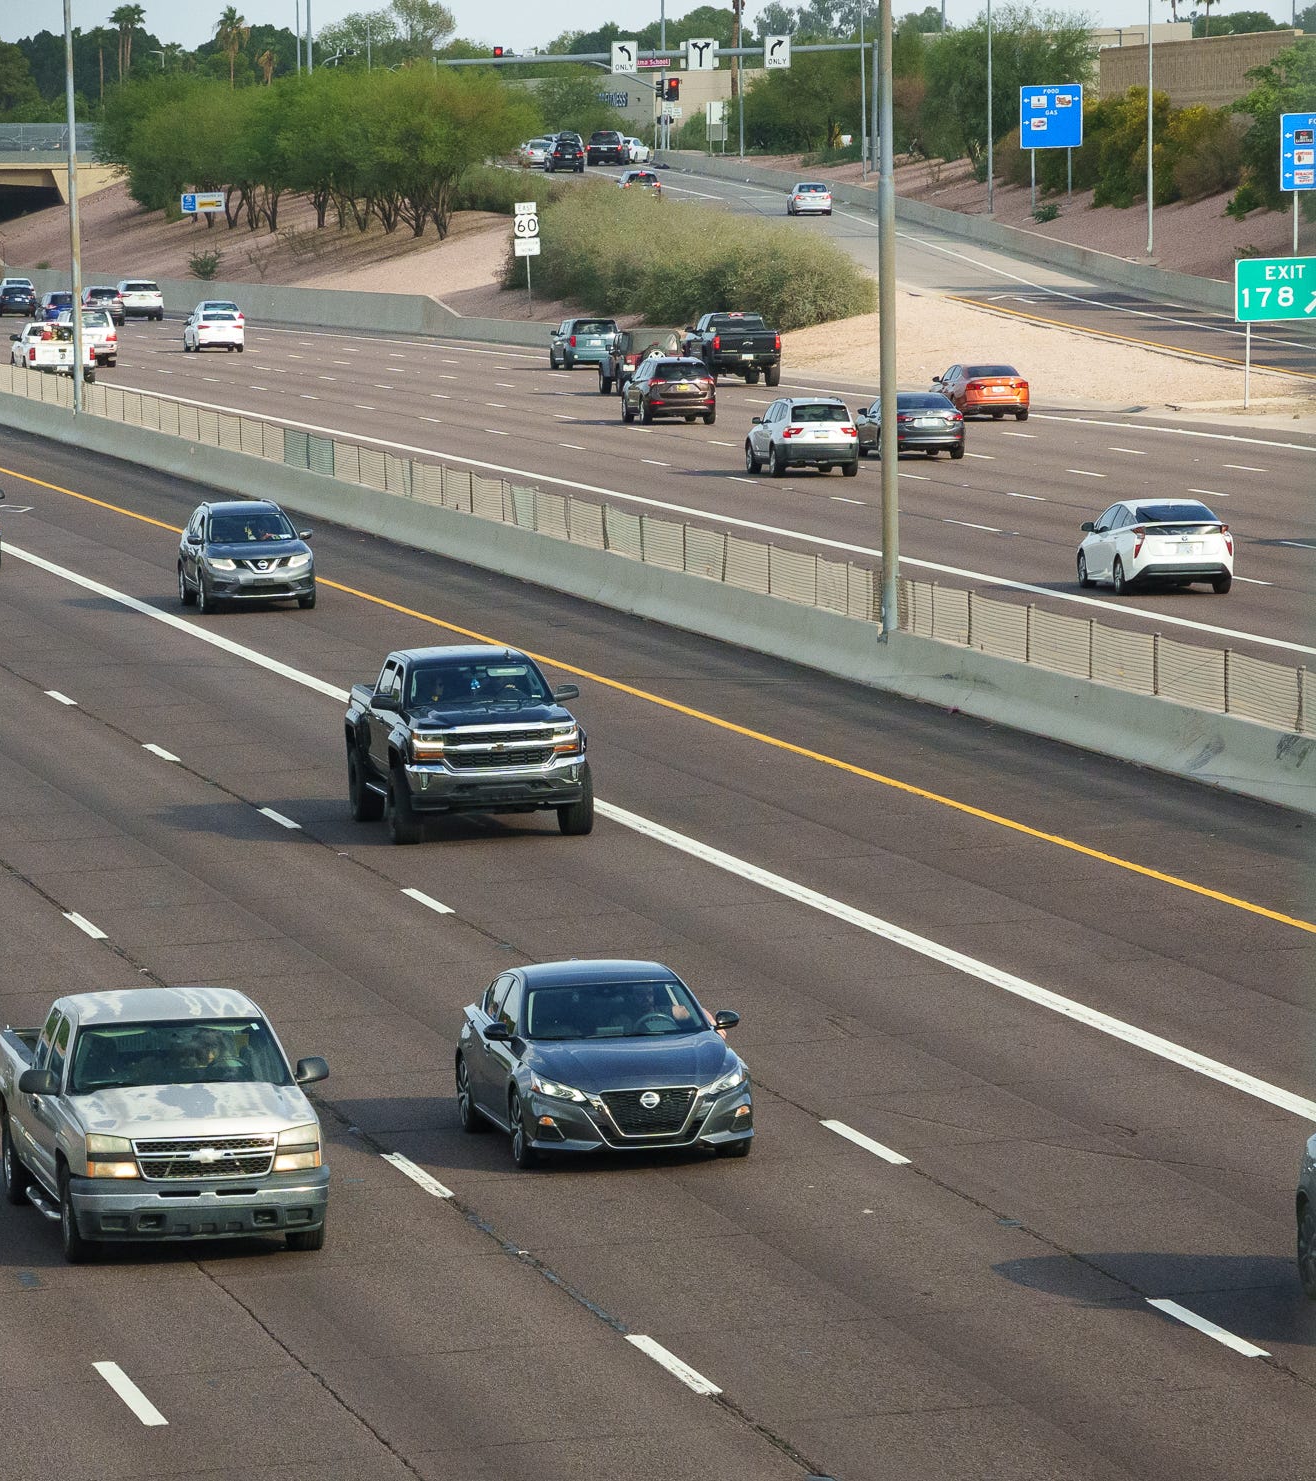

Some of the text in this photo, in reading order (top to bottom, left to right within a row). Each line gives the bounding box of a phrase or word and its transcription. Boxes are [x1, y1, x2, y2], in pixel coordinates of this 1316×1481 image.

[518, 219, 536, 232] 60
[1265, 264, 1306, 281] EXIT
[1241, 286, 1295, 308] 178
